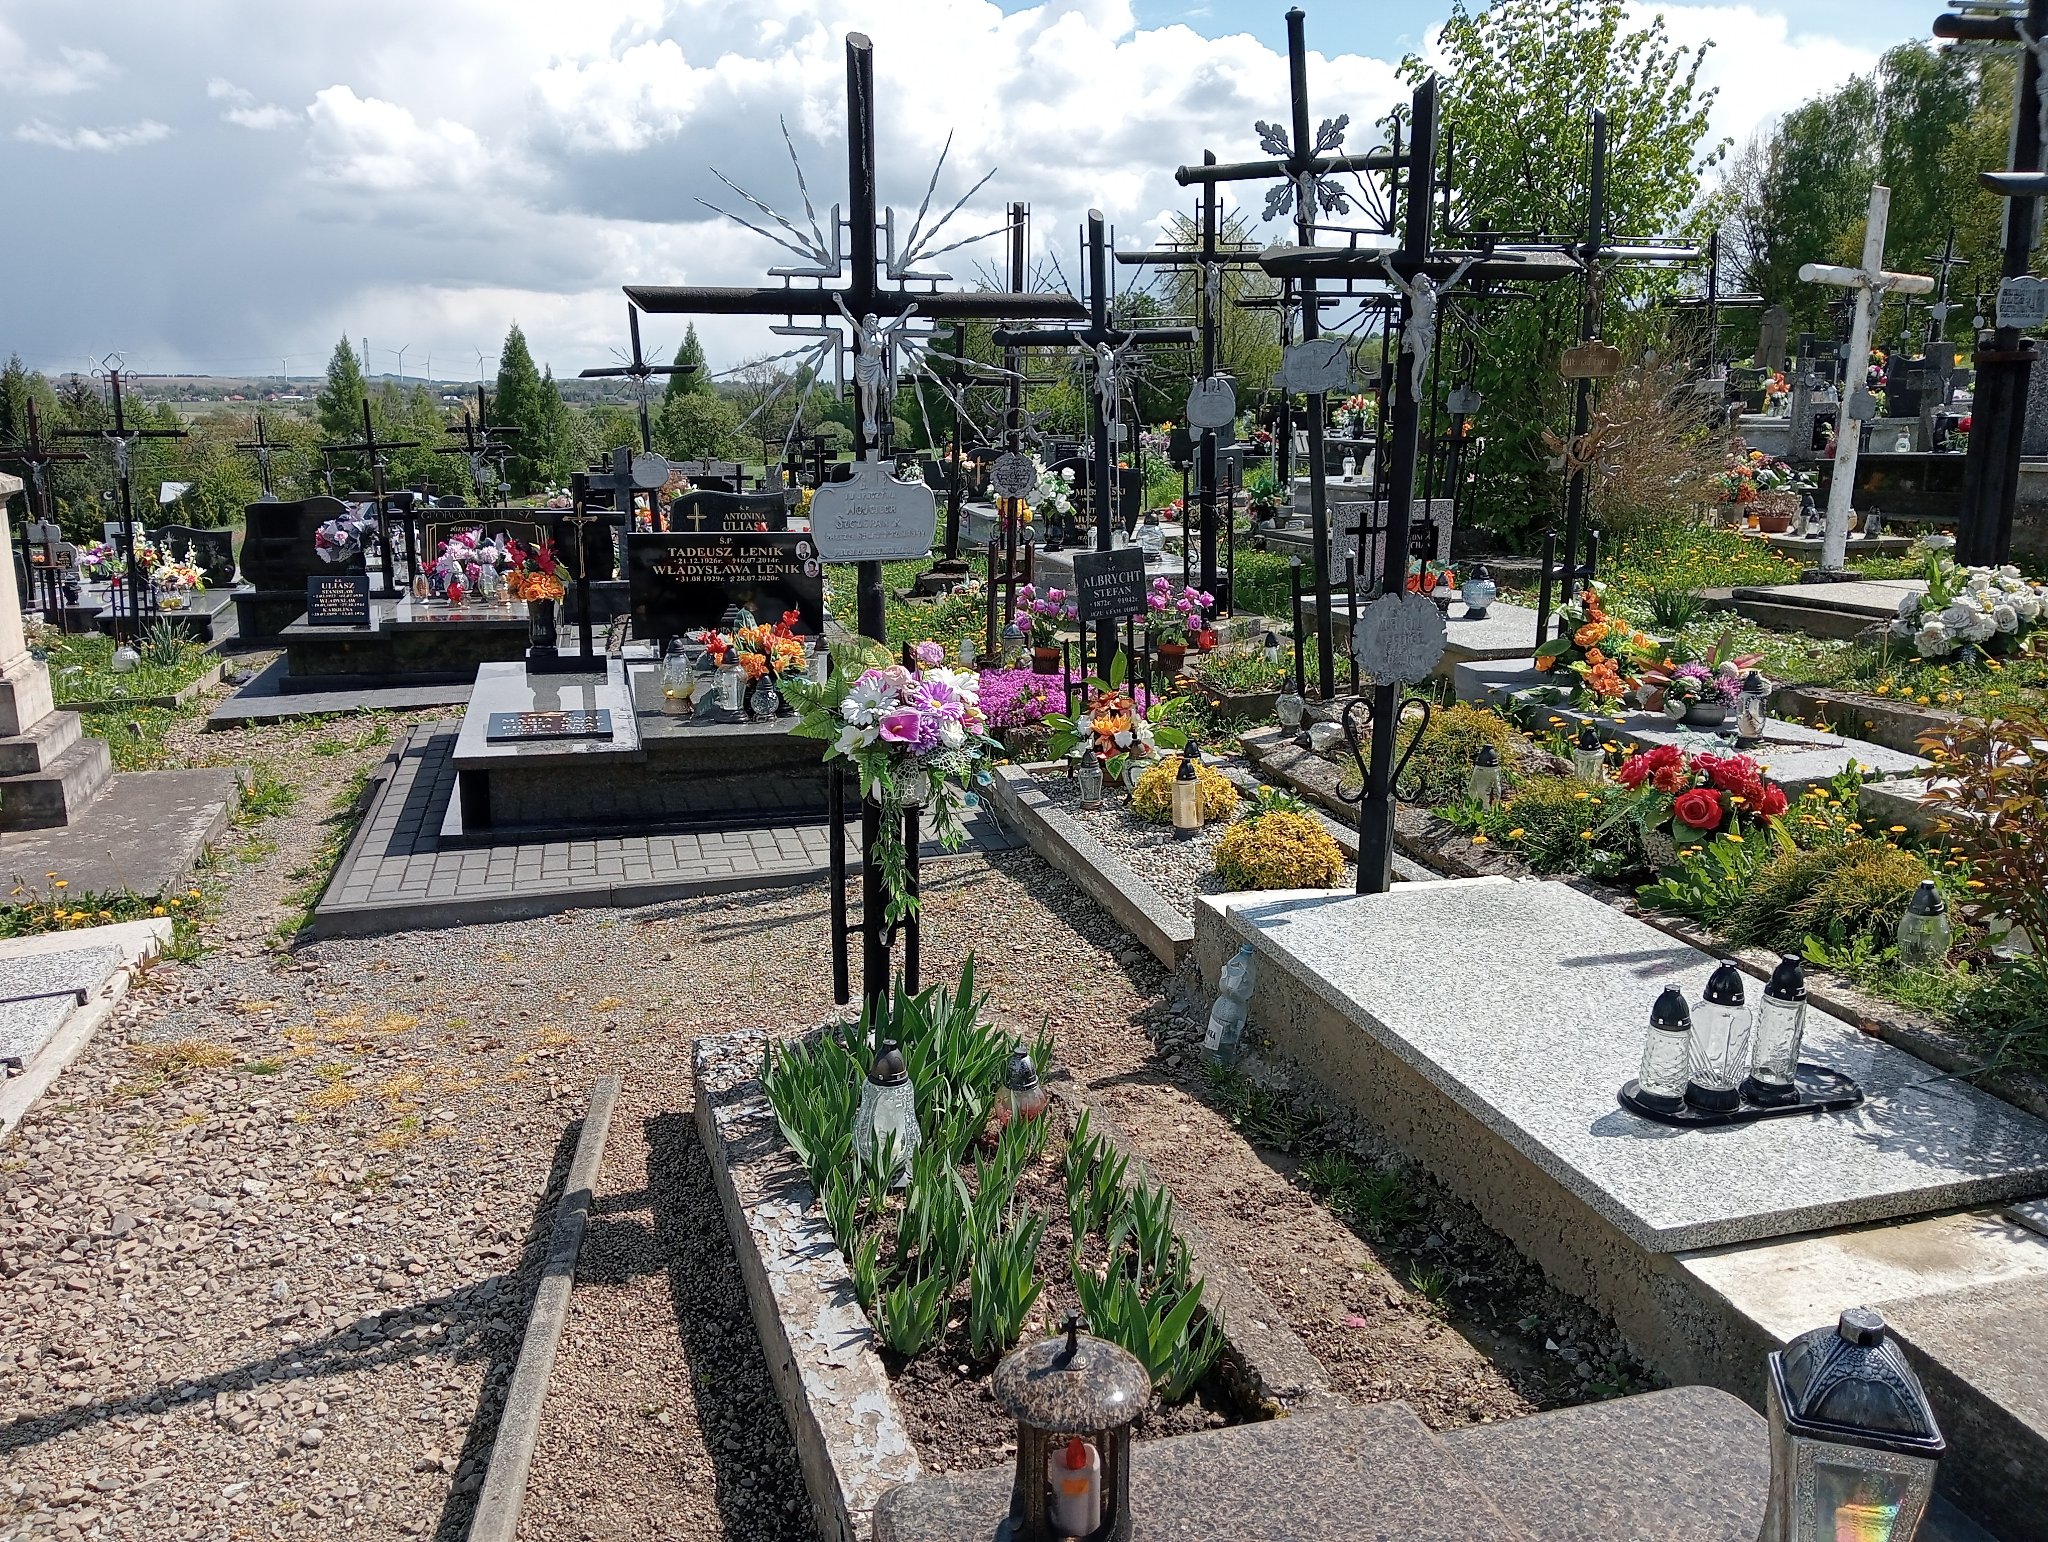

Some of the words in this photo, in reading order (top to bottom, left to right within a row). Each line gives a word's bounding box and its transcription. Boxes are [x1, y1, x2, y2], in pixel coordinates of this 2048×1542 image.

[723, 512, 767, 520] ANTONINA
[719, 536, 734, 545] Ś.P.
[667, 547, 734, 557] TADEUSZ
[740, 547, 784, 556] LENIK
[652, 565, 751, 575] WŁADYSŁAWA
[757, 564, 801, 574] LENIK
[1082, 569, 1142, 589] ALBRYCHT
[1093, 585, 1132, 599] STEFAN
